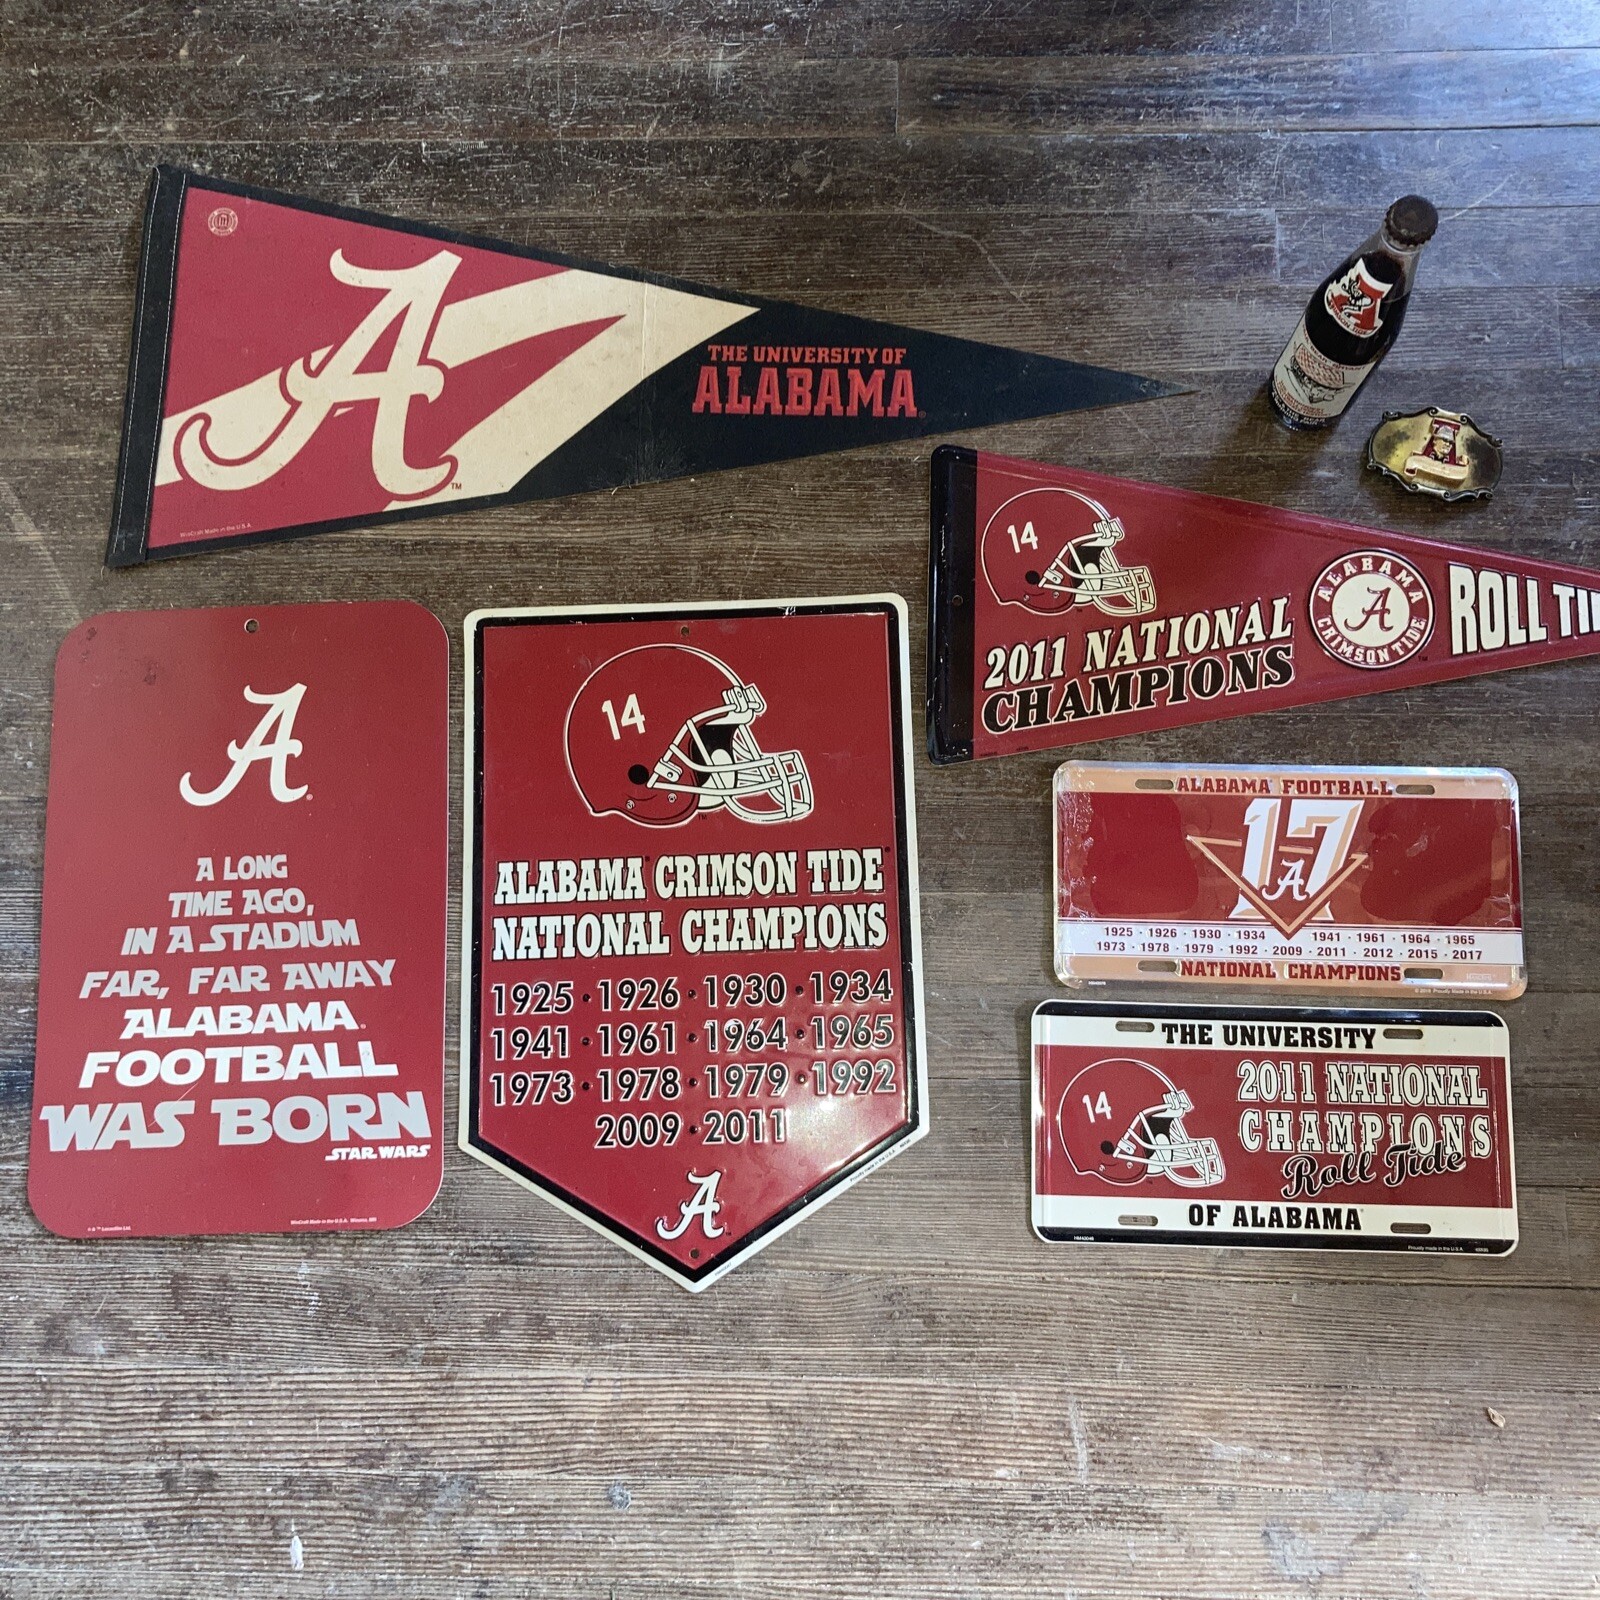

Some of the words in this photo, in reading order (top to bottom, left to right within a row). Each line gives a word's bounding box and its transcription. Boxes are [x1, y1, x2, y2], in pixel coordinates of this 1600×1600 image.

[180, 248, 462, 495] A
[708, 345, 748, 362] THE
[753, 346, 878, 365] UNIVERSITY
[881, 348, 907, 365] OF
[692, 366, 918, 418] ALABAMA
[1006, 521, 1038, 554] 14
[1317, 557, 1425, 603] ALABAMA
[1449, 562, 1549, 656] ROLL
[984, 636, 1068, 691] 2011
[1081, 595, 1295, 674] NATIONAL
[1316, 617, 1390, 666] CRIMSON
[1391, 617, 1427, 657] TIDE
[981, 644, 1296, 735] CHAMPIONS
[601, 693, 646, 741] 14
[179, 682, 309, 807] A
[1176, 777, 1271, 794] ALABAMA
[1283, 779, 1394, 796] FOOTBALL
[195, 857, 215, 882] A
[223, 854, 288, 880] LONG
[494, 857, 647, 905] ALABAMA
[653, 851, 798, 899] CRIMSON
[807, 847, 884, 893] TIDE
[1228, 798, 1365, 920] 17
[168, 890, 233, 918] TIME
[242, 887, 315, 916] AGO,
[120, 927, 157, 956] IN
[166, 925, 194, 954] A
[198, 918, 361, 952] STADIUM
[492, 911, 671, 961] NATIONAL
[681, 903, 889, 955] CHAMPIONS
[1097, 941, 1126, 951] 1973
[1140, 942, 1170, 952] 1978
[1184, 944, 1214, 954] 1979
[1229, 945, 1258, 955] 1992
[1273, 946, 1302, 956] 2009
[1317, 947, 1346, 957] 2011
[1363, 948, 1393, 958] 2012
[1408, 949, 1438, 959] 2015
[1453, 950, 1482, 960] 2017
[1104, 926, 1133, 937] 1925
[1148, 928, 1178, 938] 1926
[1192, 929, 1222, 939] 1930
[1236, 930, 1266, 940] 1934
[1312, 932, 1341, 942] 1941
[1356, 933, 1385, 943] 1961
[1401, 934, 1431, 944] 1964
[1446, 935, 1475, 945] 1965
[78, 969, 170, 1000] FAR,
[188, 965, 270, 995] FAR
[282, 959, 397, 992] AWAY
[491, 980, 574, 1016] 1925
[597, 977, 681, 1012] 1926
[704, 973, 787, 1008] 1930
[810, 969, 893, 1005] 1934
[1180, 960, 1277, 978] NATIONAL
[1288, 963, 1401, 982] CHAMPIONS
[119, 1000, 360, 1040] ALABAMA
[491, 1025, 571, 1061] 1941
[597, 1021, 677, 1057] 1961
[704, 1017, 788, 1053] 1964
[811, 1014, 895, 1051] 1965
[1161, 1023, 1217, 1046] THE
[1222, 1025, 1376, 1050] UNIVERSITY
[78, 1041, 399, 1089] FOOTBALL
[490, 1070, 574, 1106] 1973
[597, 1066, 681, 1102] 1978
[704, 1062, 789, 1098] 1979
[812, 1059, 896, 1095] 1992
[1237, 1060, 1317, 1104] 2011
[1326, 1062, 1489, 1107] NATIONAL
[39, 1100, 196, 1152] WAS
[210, 1091, 432, 1146] BORN
[595, 1112, 681, 1149] 2009
[703, 1109, 785, 1144] 2011
[1081, 1091, 1112, 1124] 14
[324, 1146, 377, 1161] STAR
[378, 1144, 431, 1159] WARS
[1238, 1109, 1493, 1158] CHAMPIONS
[1281, 1150, 1377, 1199] Roll
[1383, 1137, 1467, 1187] Tide
[656, 1170, 725, 1240] A
[1188, 1204, 1220, 1226] OF
[1232, 1206, 1362, 1231] ALABAMA
